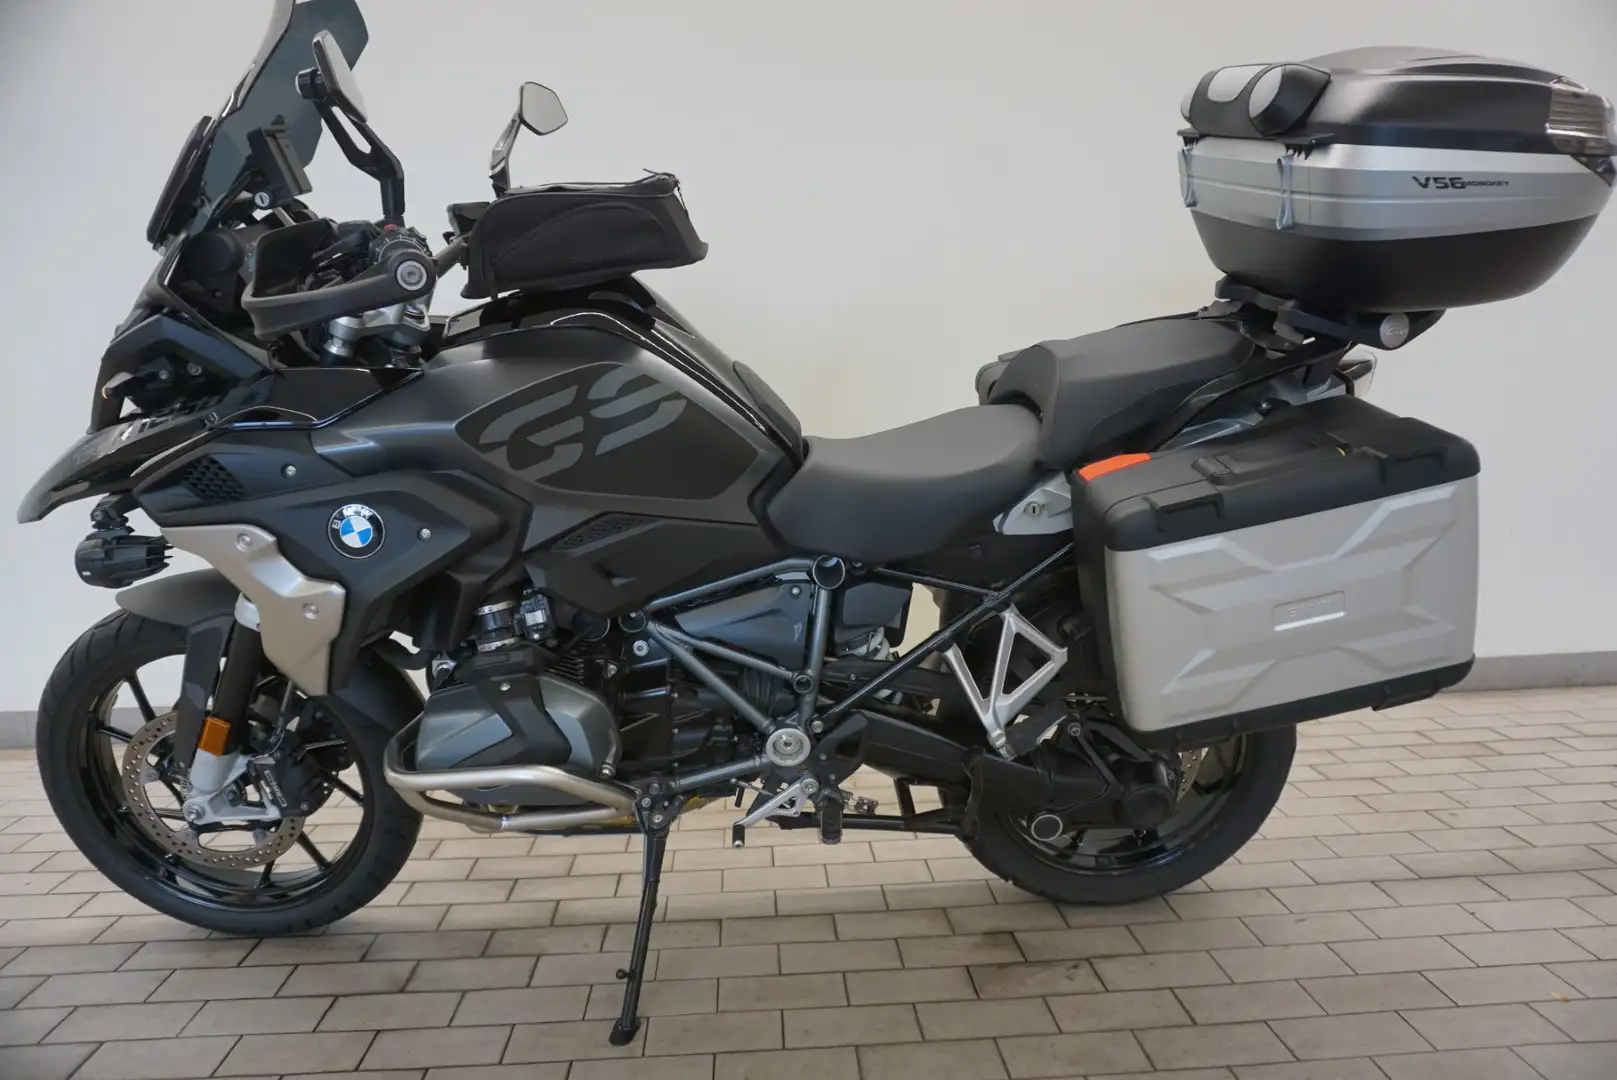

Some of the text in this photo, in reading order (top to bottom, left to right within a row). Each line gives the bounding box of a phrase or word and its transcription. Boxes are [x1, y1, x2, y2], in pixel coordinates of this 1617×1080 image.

[1411, 176, 1466, 189] V56
[479, 364, 687, 482] GS
[331, 505, 374, 530] BMW
